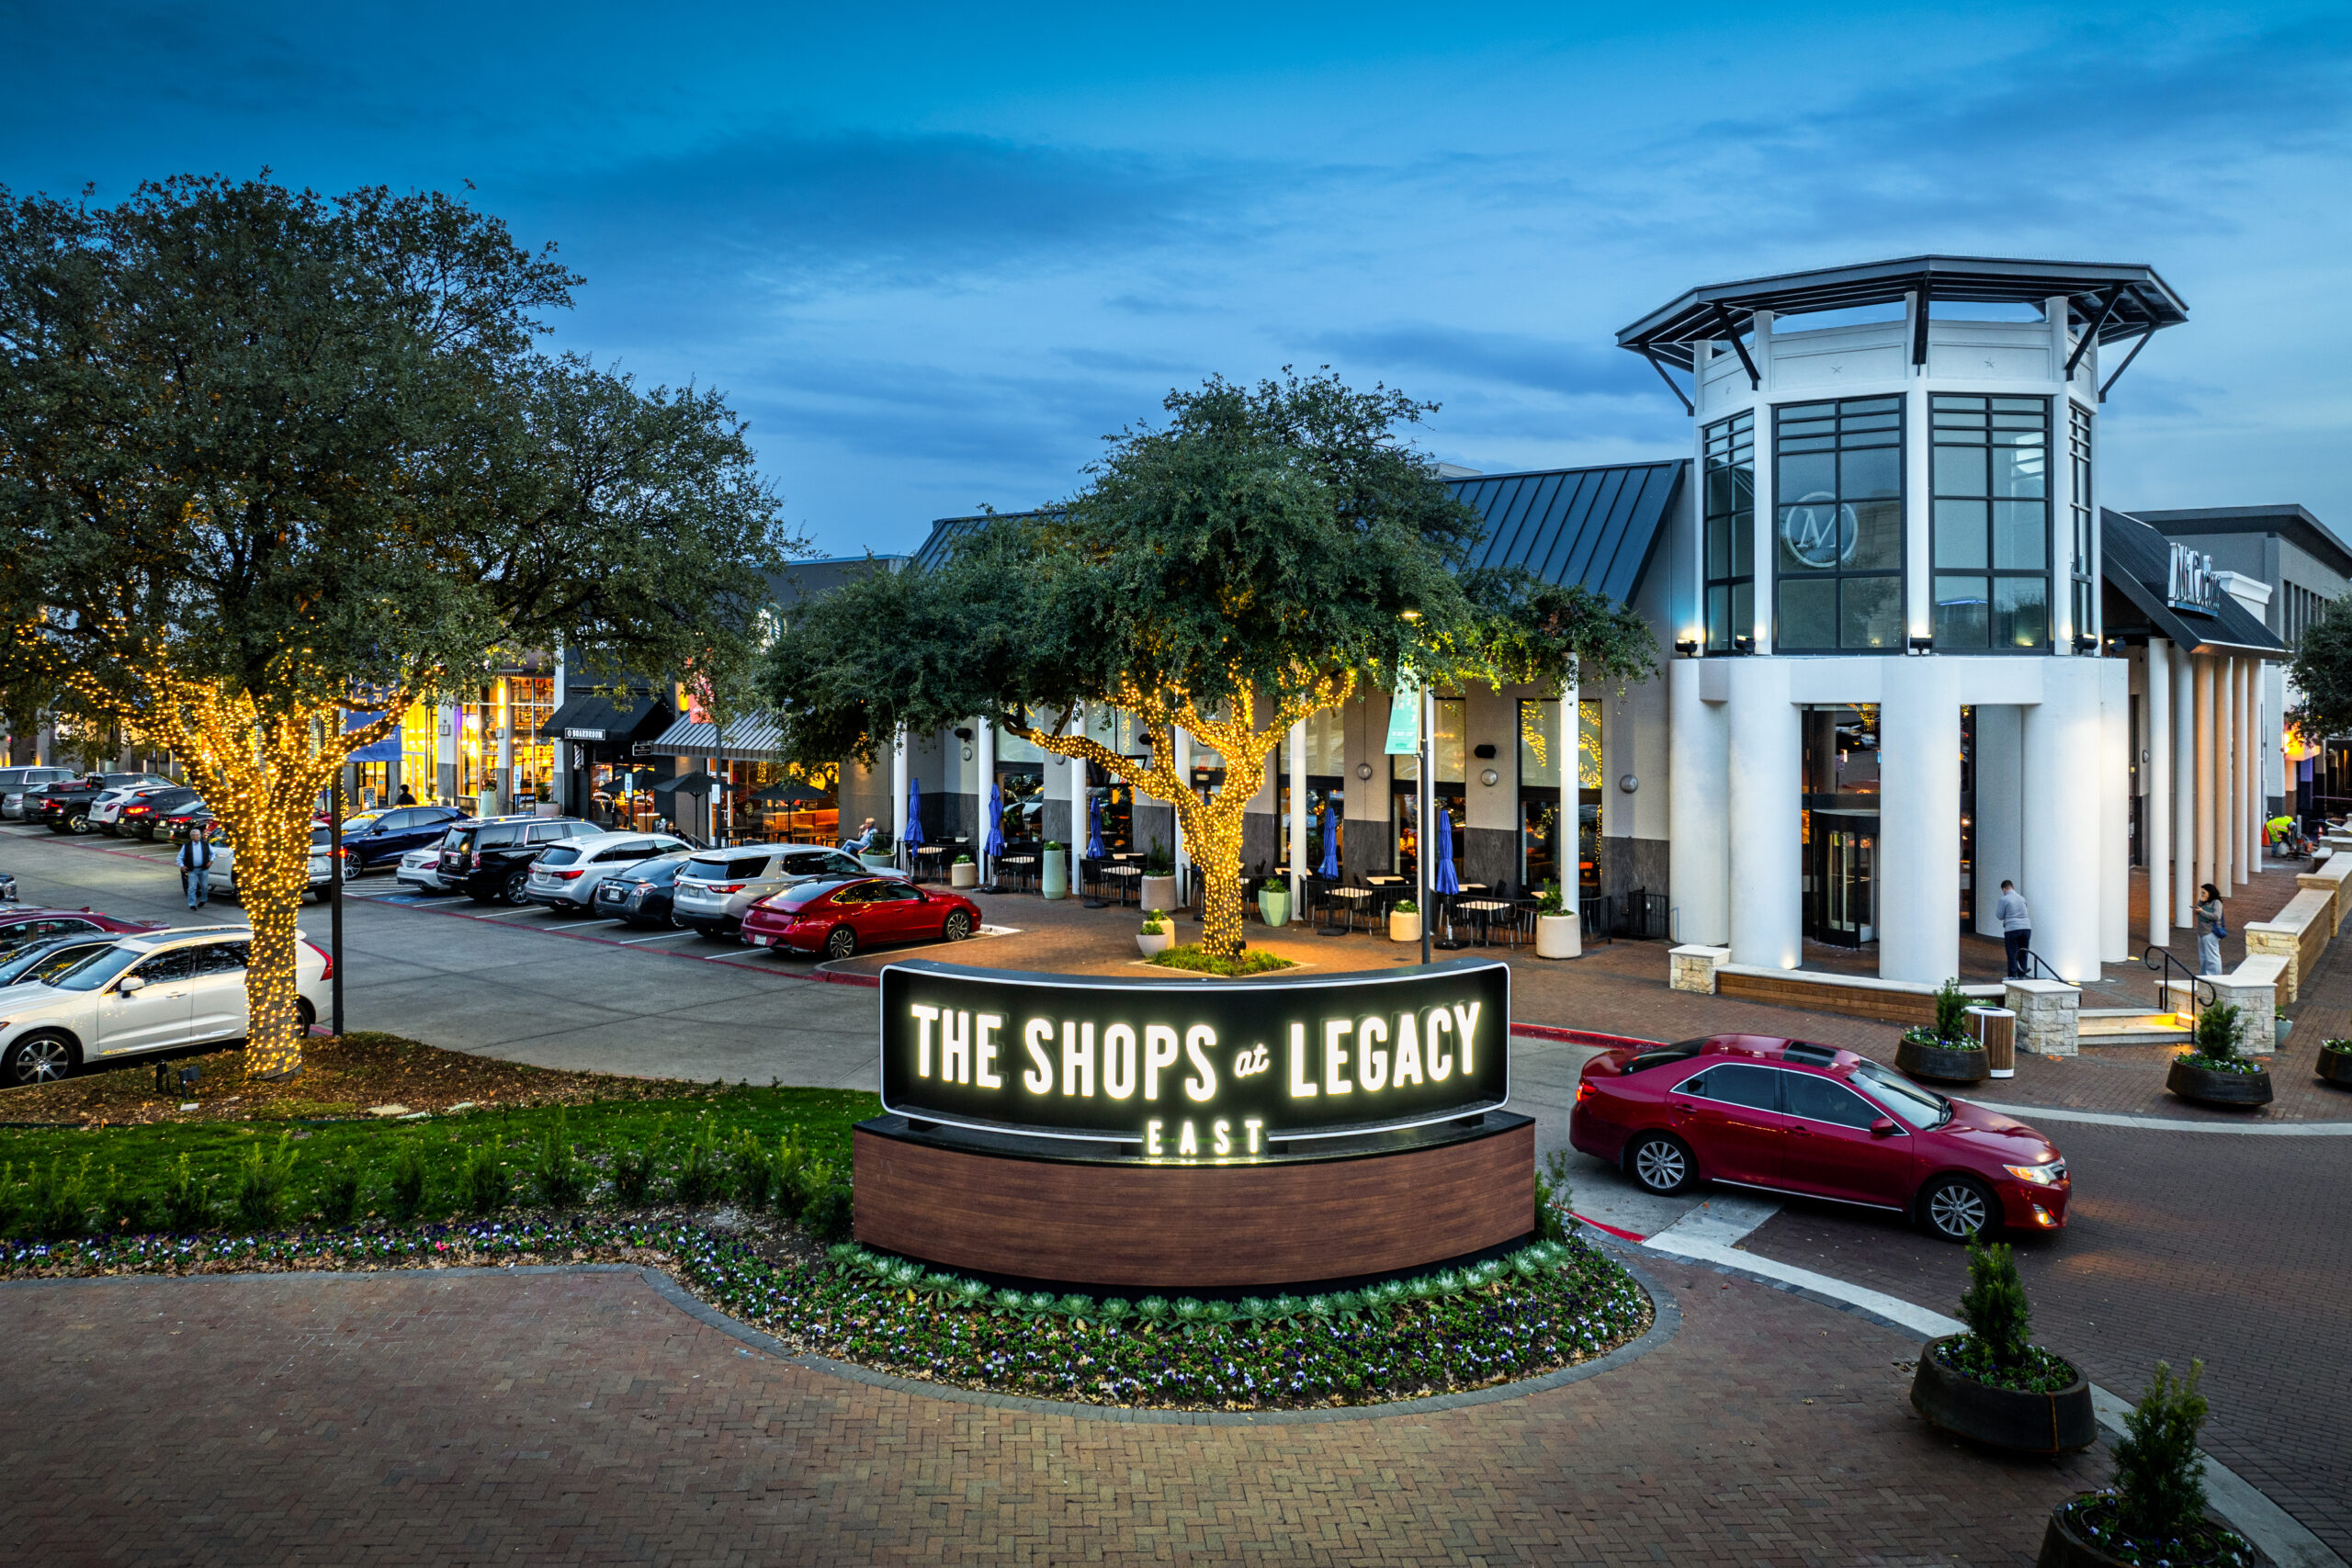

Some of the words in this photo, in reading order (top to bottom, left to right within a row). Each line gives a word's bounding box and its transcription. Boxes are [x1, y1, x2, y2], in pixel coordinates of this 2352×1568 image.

[572, 729, 603, 739] BOARDROOM
[911, 1004, 1001, 1089] THE
[1023, 1018, 1216, 1102] SHOPS
[1235, 1043, 1270, 1078] at
[1290, 1001, 1481, 1098] LEGACY
[1148, 1120, 1263, 1156] EAST
